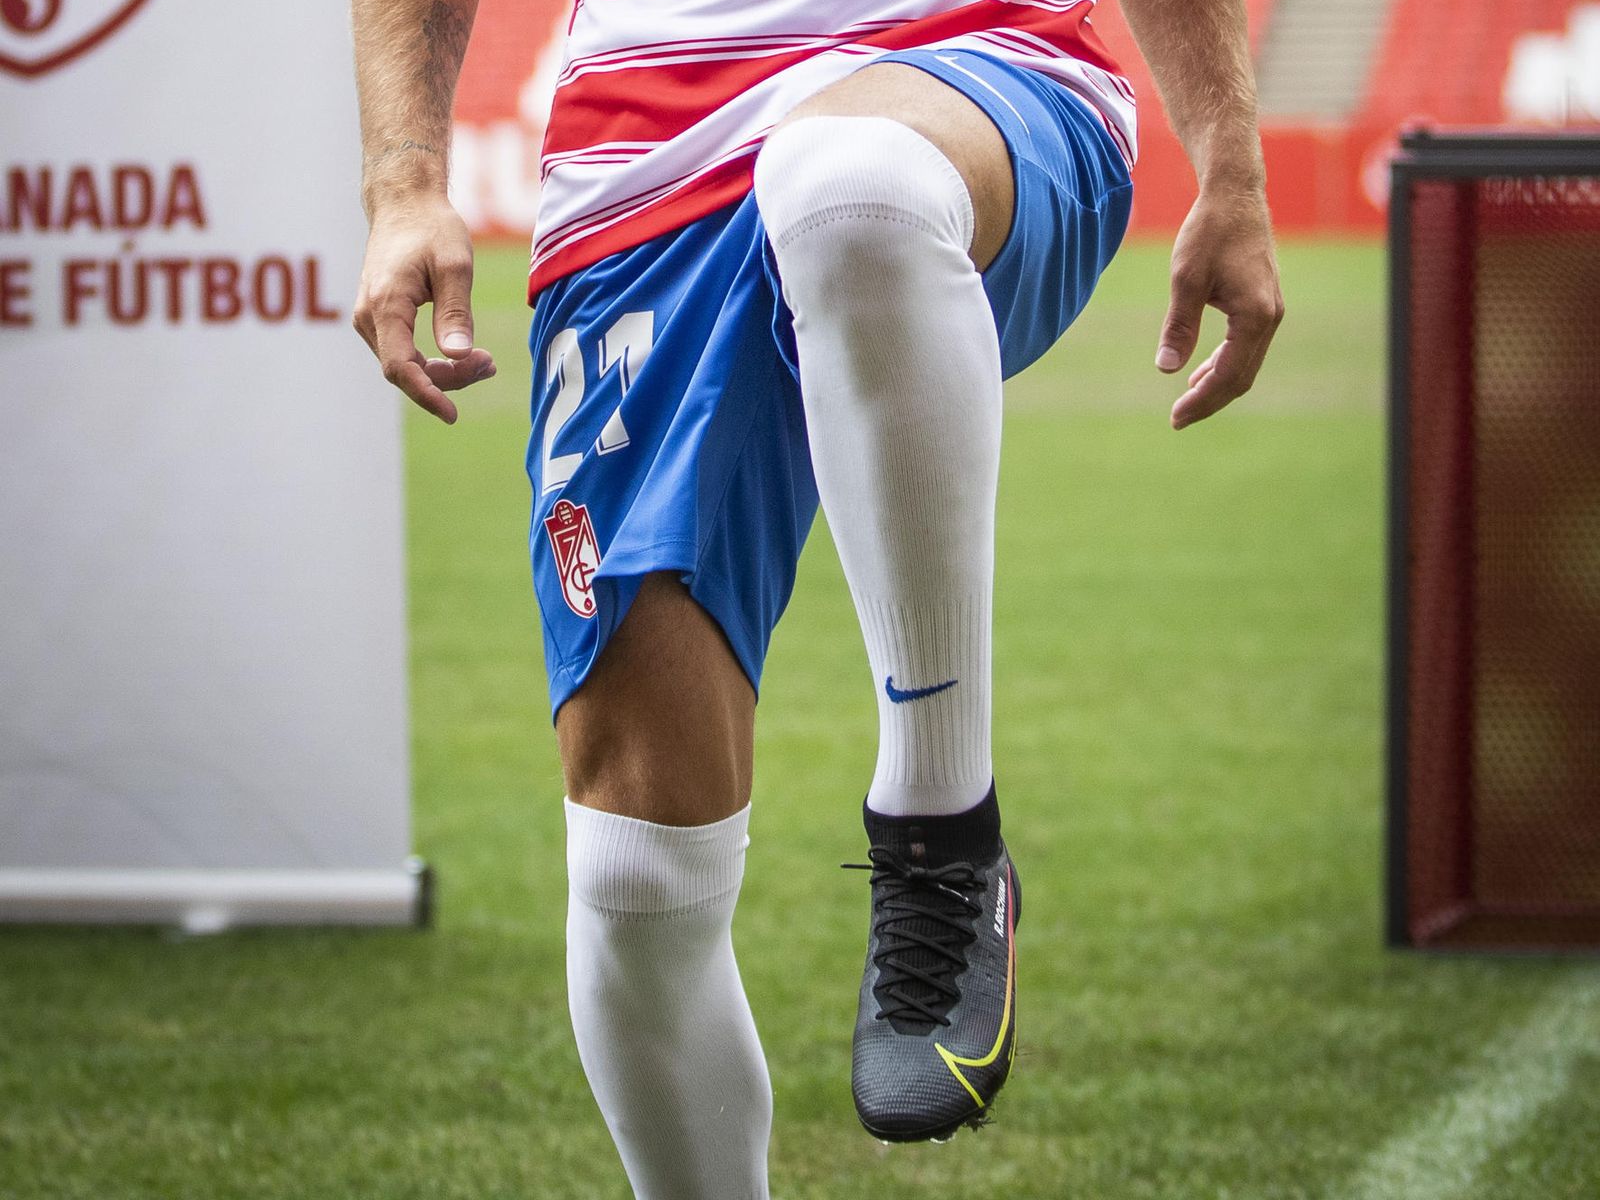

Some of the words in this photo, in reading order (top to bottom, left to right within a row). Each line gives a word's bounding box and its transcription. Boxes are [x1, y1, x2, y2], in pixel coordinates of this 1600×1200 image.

[0, 164, 207, 232] NADA
[0, 259, 33, 327] E
[62, 240, 340, 326] FÚTBOL
[541, 309, 655, 496] 21
